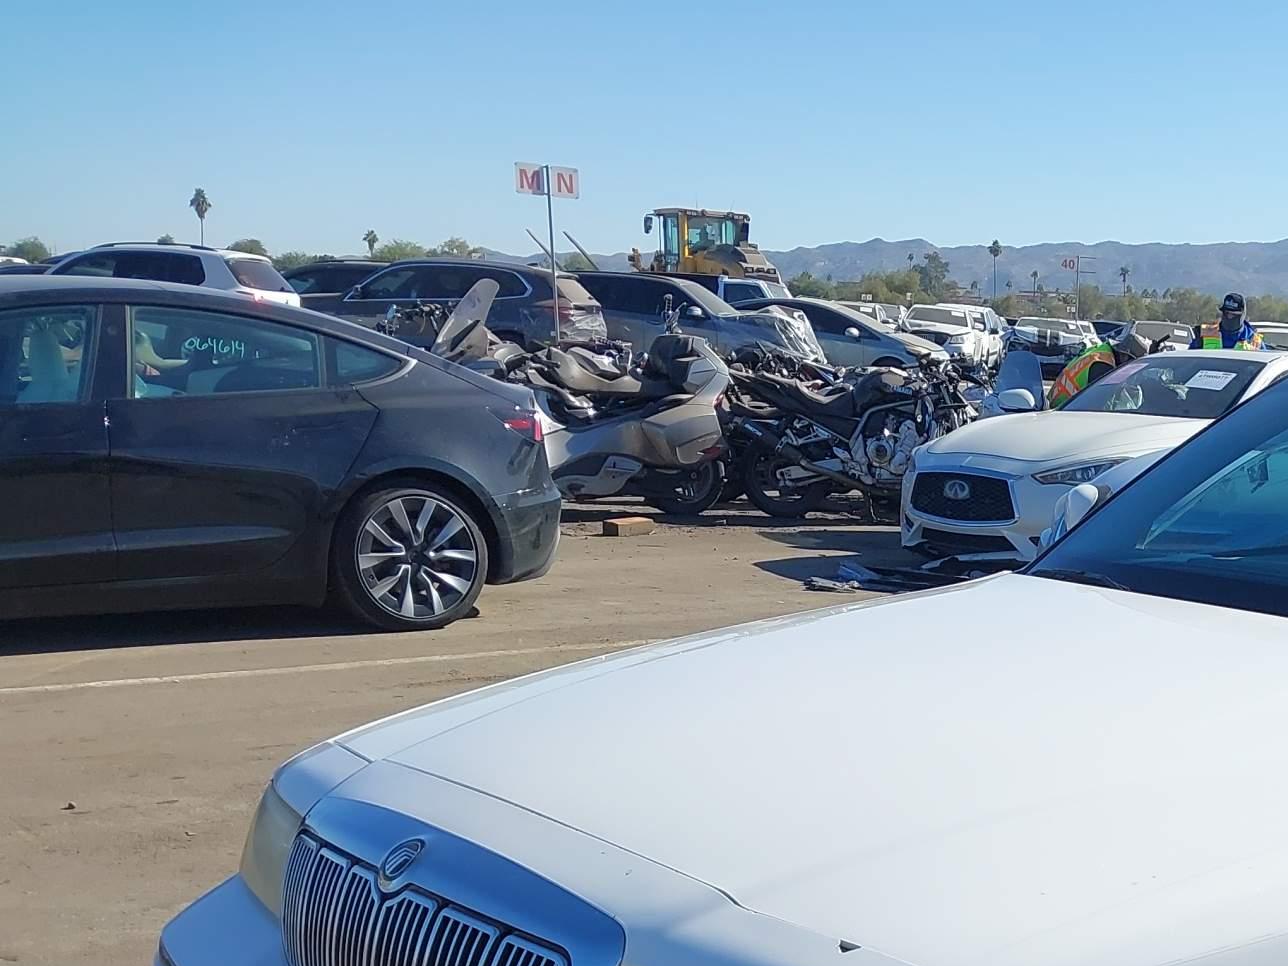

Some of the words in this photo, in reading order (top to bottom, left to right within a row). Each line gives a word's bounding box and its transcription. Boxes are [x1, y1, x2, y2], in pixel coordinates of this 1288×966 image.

[518, 168, 542, 192] M
[556, 172, 574, 194] N
[1061, 259, 1075, 270] 40
